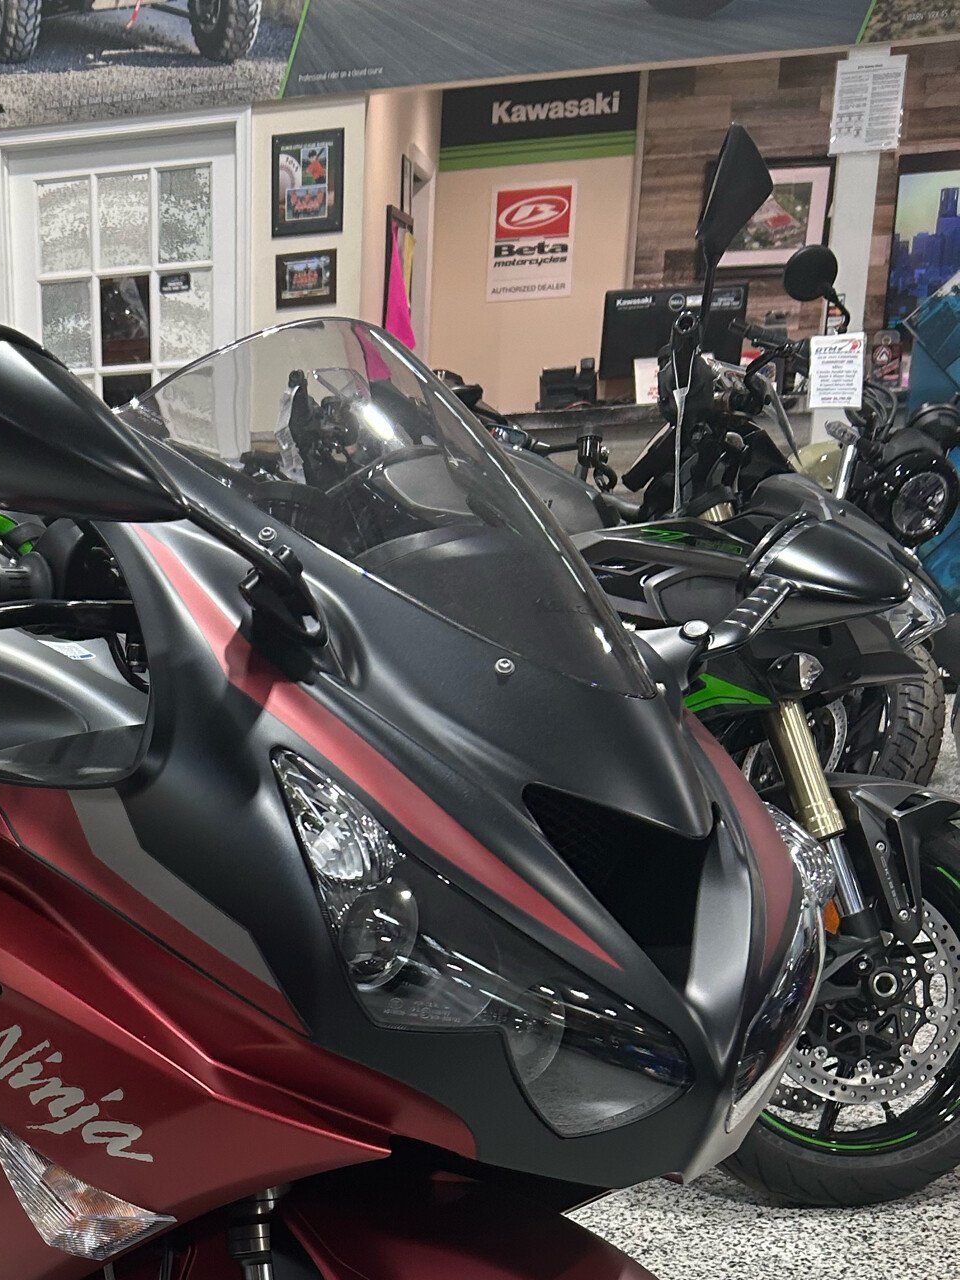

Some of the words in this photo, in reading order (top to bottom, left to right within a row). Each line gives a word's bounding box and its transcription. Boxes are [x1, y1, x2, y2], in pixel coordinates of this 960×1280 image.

[492, 91, 620, 125] Kawasaki
[494, 240, 568, 258] Beta
[494, 256, 567, 268] motorcycles
[491, 285, 536, 295] AUTHORIZED
[538, 283, 566, 292] DEALER
